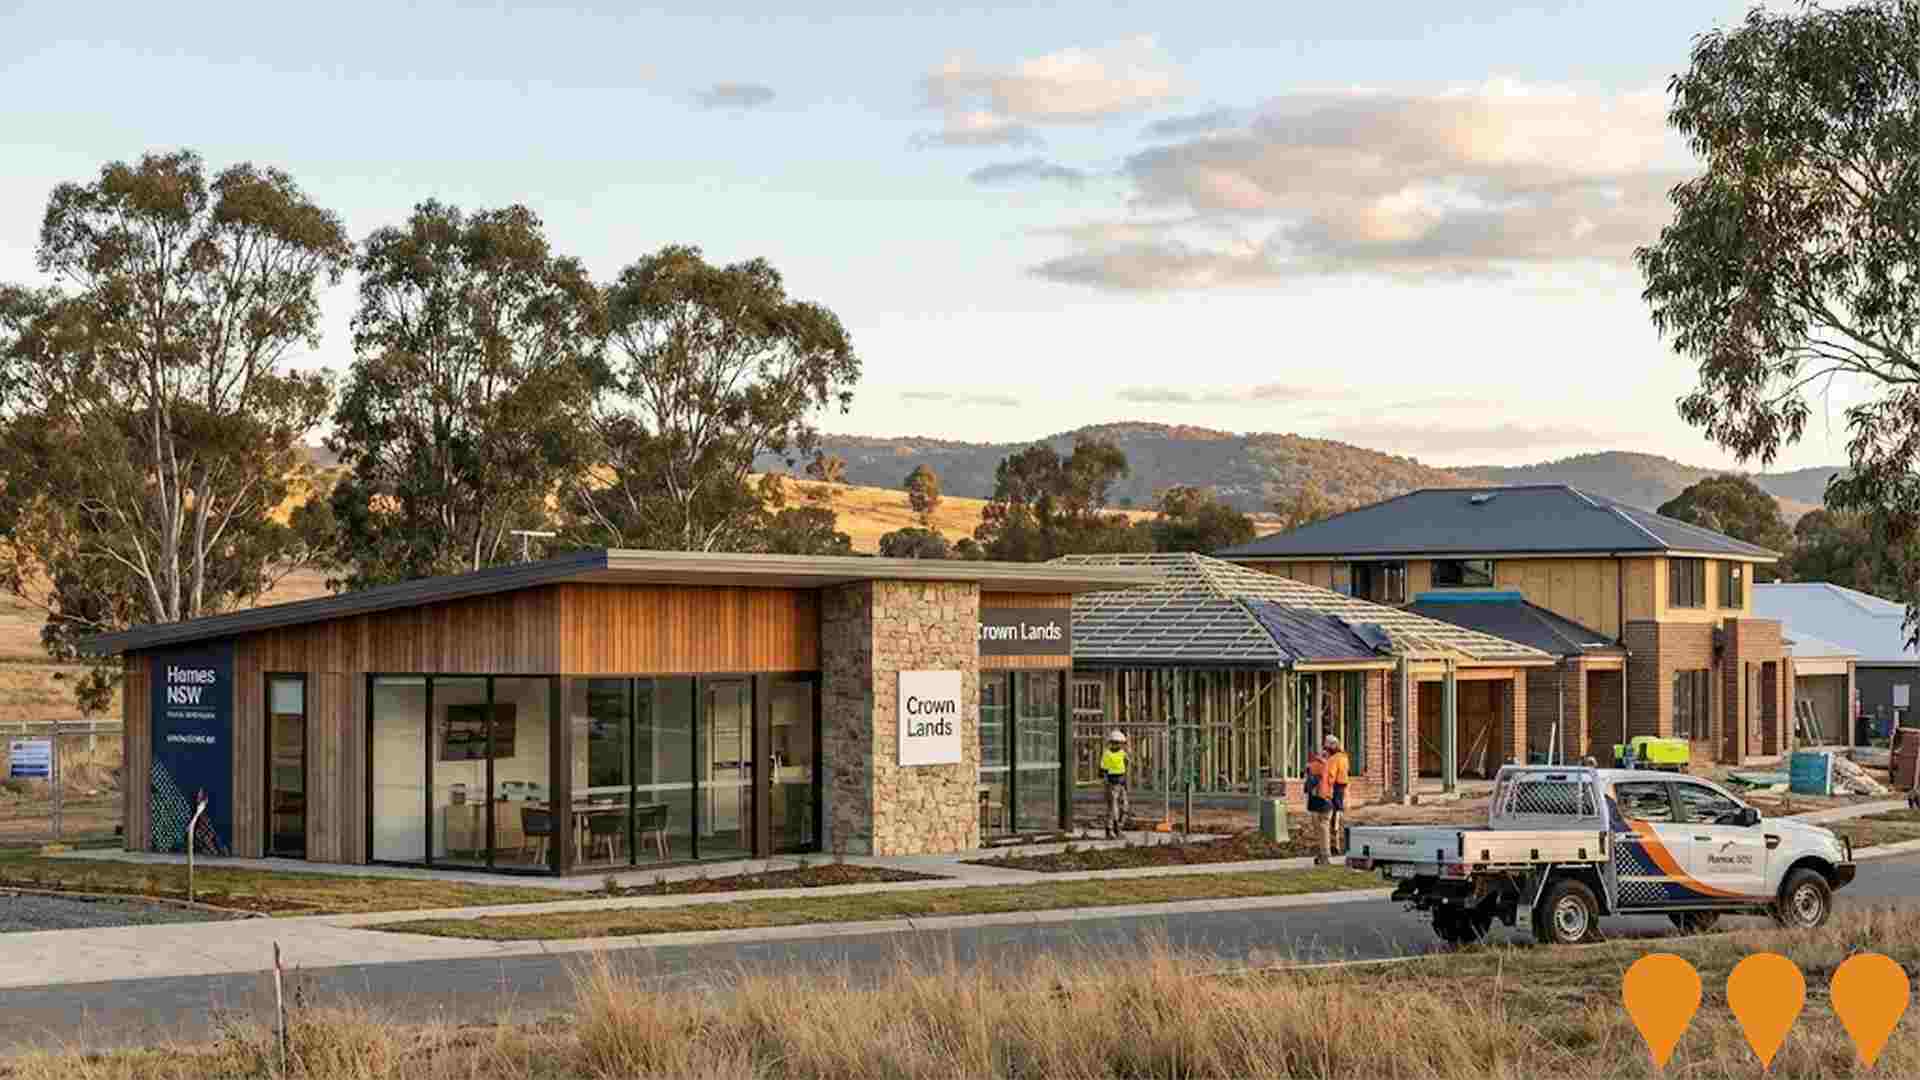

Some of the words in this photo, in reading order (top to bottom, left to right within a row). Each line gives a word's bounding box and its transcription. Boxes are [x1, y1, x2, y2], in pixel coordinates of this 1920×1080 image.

[1021, 621, 1062, 640] Lands
[167, 665, 216, 684] Homes
[167, 686, 202, 704] NSW
[906, 696, 955, 714] Crown
[907, 717, 952, 736] Lands
